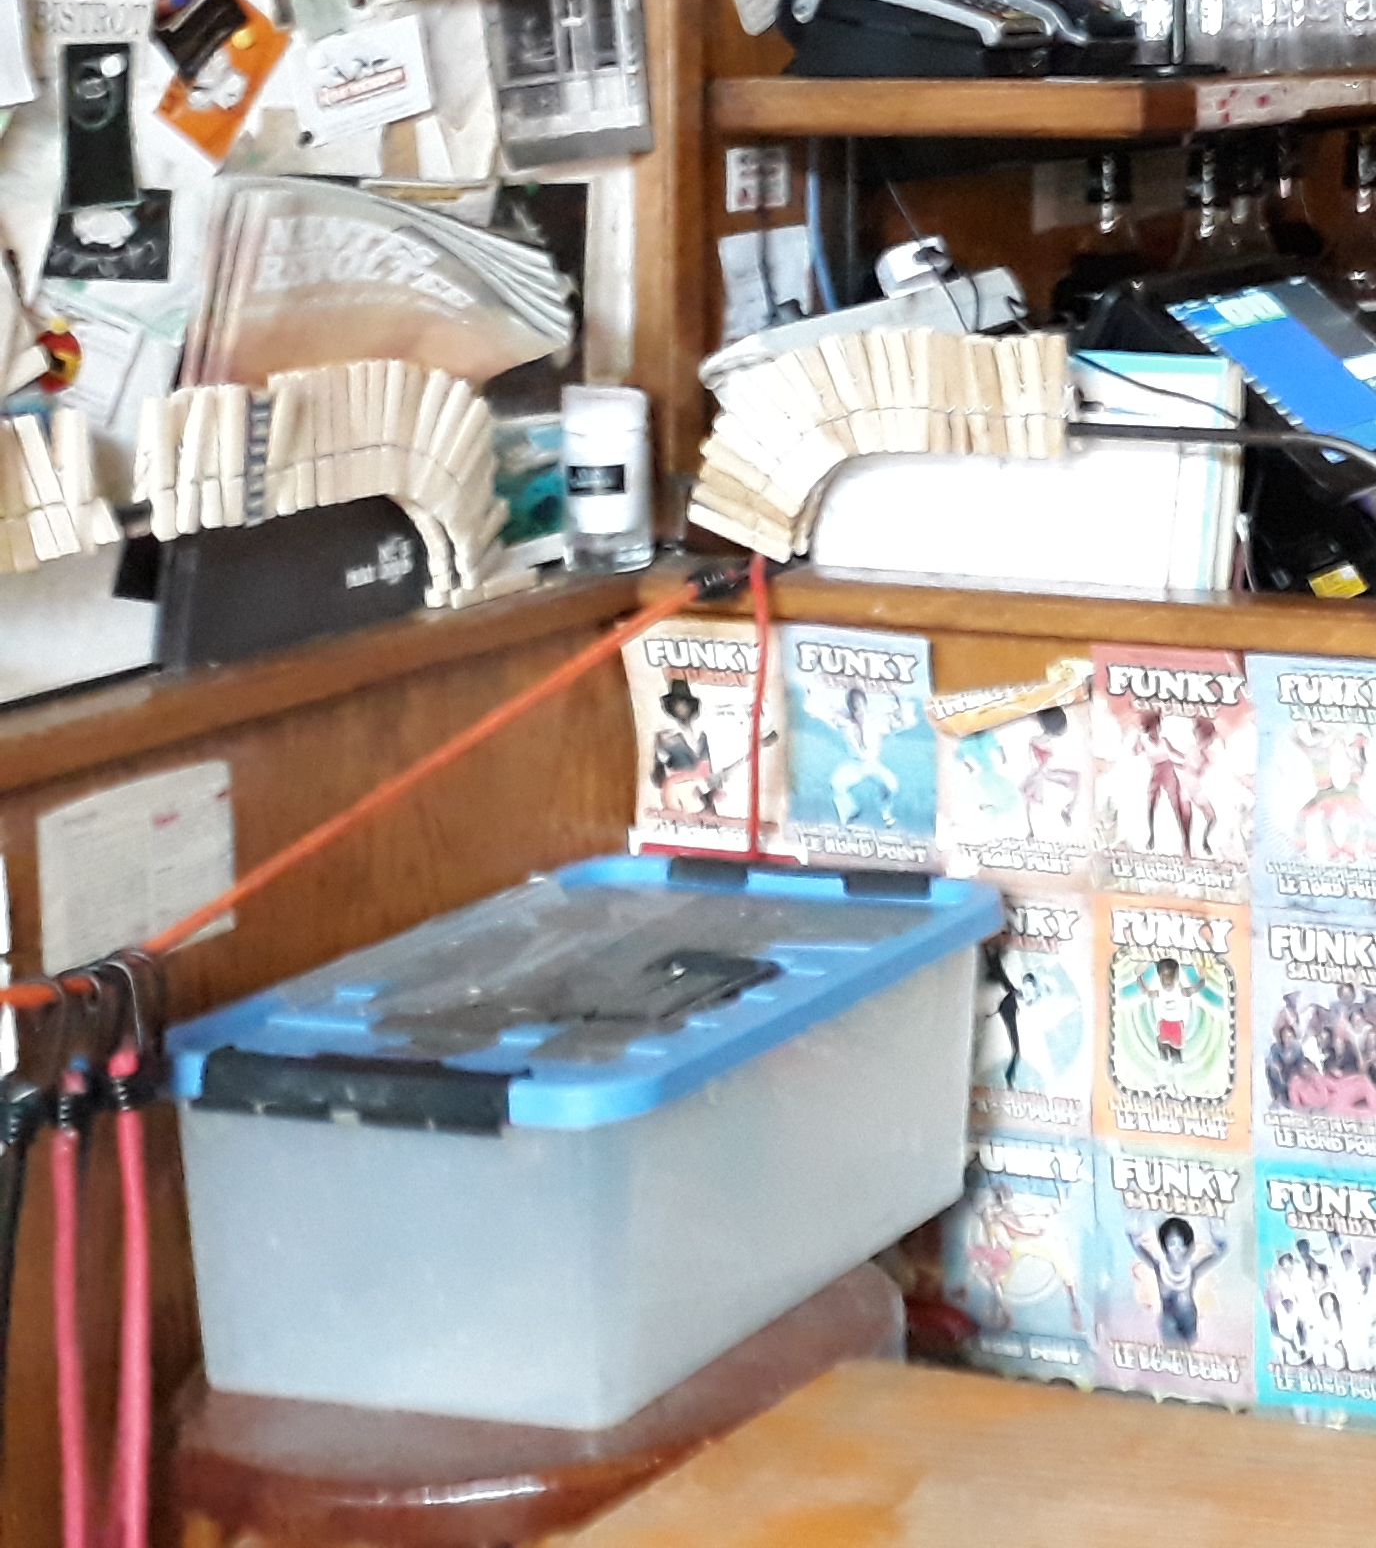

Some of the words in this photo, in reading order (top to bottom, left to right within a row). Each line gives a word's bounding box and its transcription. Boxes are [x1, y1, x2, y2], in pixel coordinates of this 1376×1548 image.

[645, 639, 760, 673] FUNKY
[797, 641, 918, 683] FUNKY
[1107, 664, 1246, 705] FUNKY
[1110, 908, 1235, 953] FUNKY
[1274, 1127, 1296, 1149] LE
[1297, 1131, 1345, 1153] ROND
[1111, 1156, 1240, 1203] FUNKY
[1113, 1346, 1135, 1369] LE
